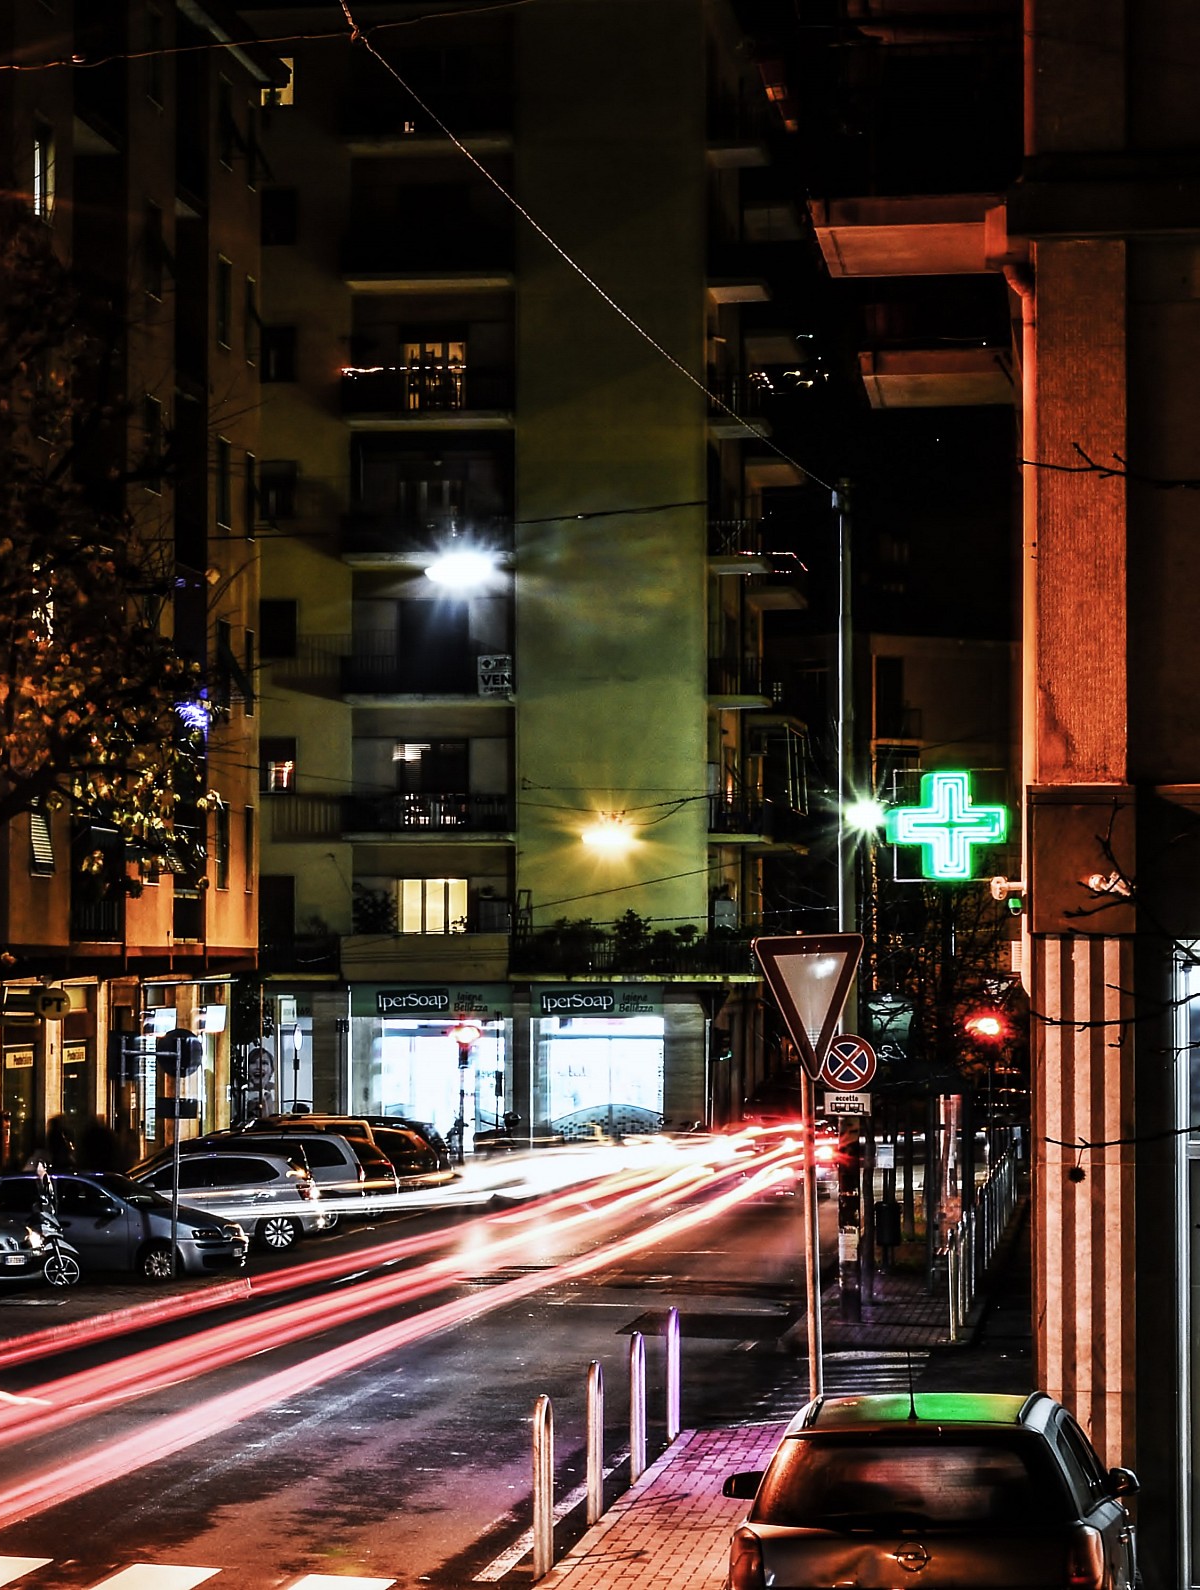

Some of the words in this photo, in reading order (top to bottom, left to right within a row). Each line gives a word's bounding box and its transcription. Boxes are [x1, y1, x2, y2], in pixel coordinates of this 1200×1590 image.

[42, 997, 64, 1012] PT
[378, 993, 449, 1012] IperSoap
[542, 993, 614, 1013] IperSoap
[622, 992, 648, 1003] Igiene
[619, 1003, 654, 1013] Bellezza
